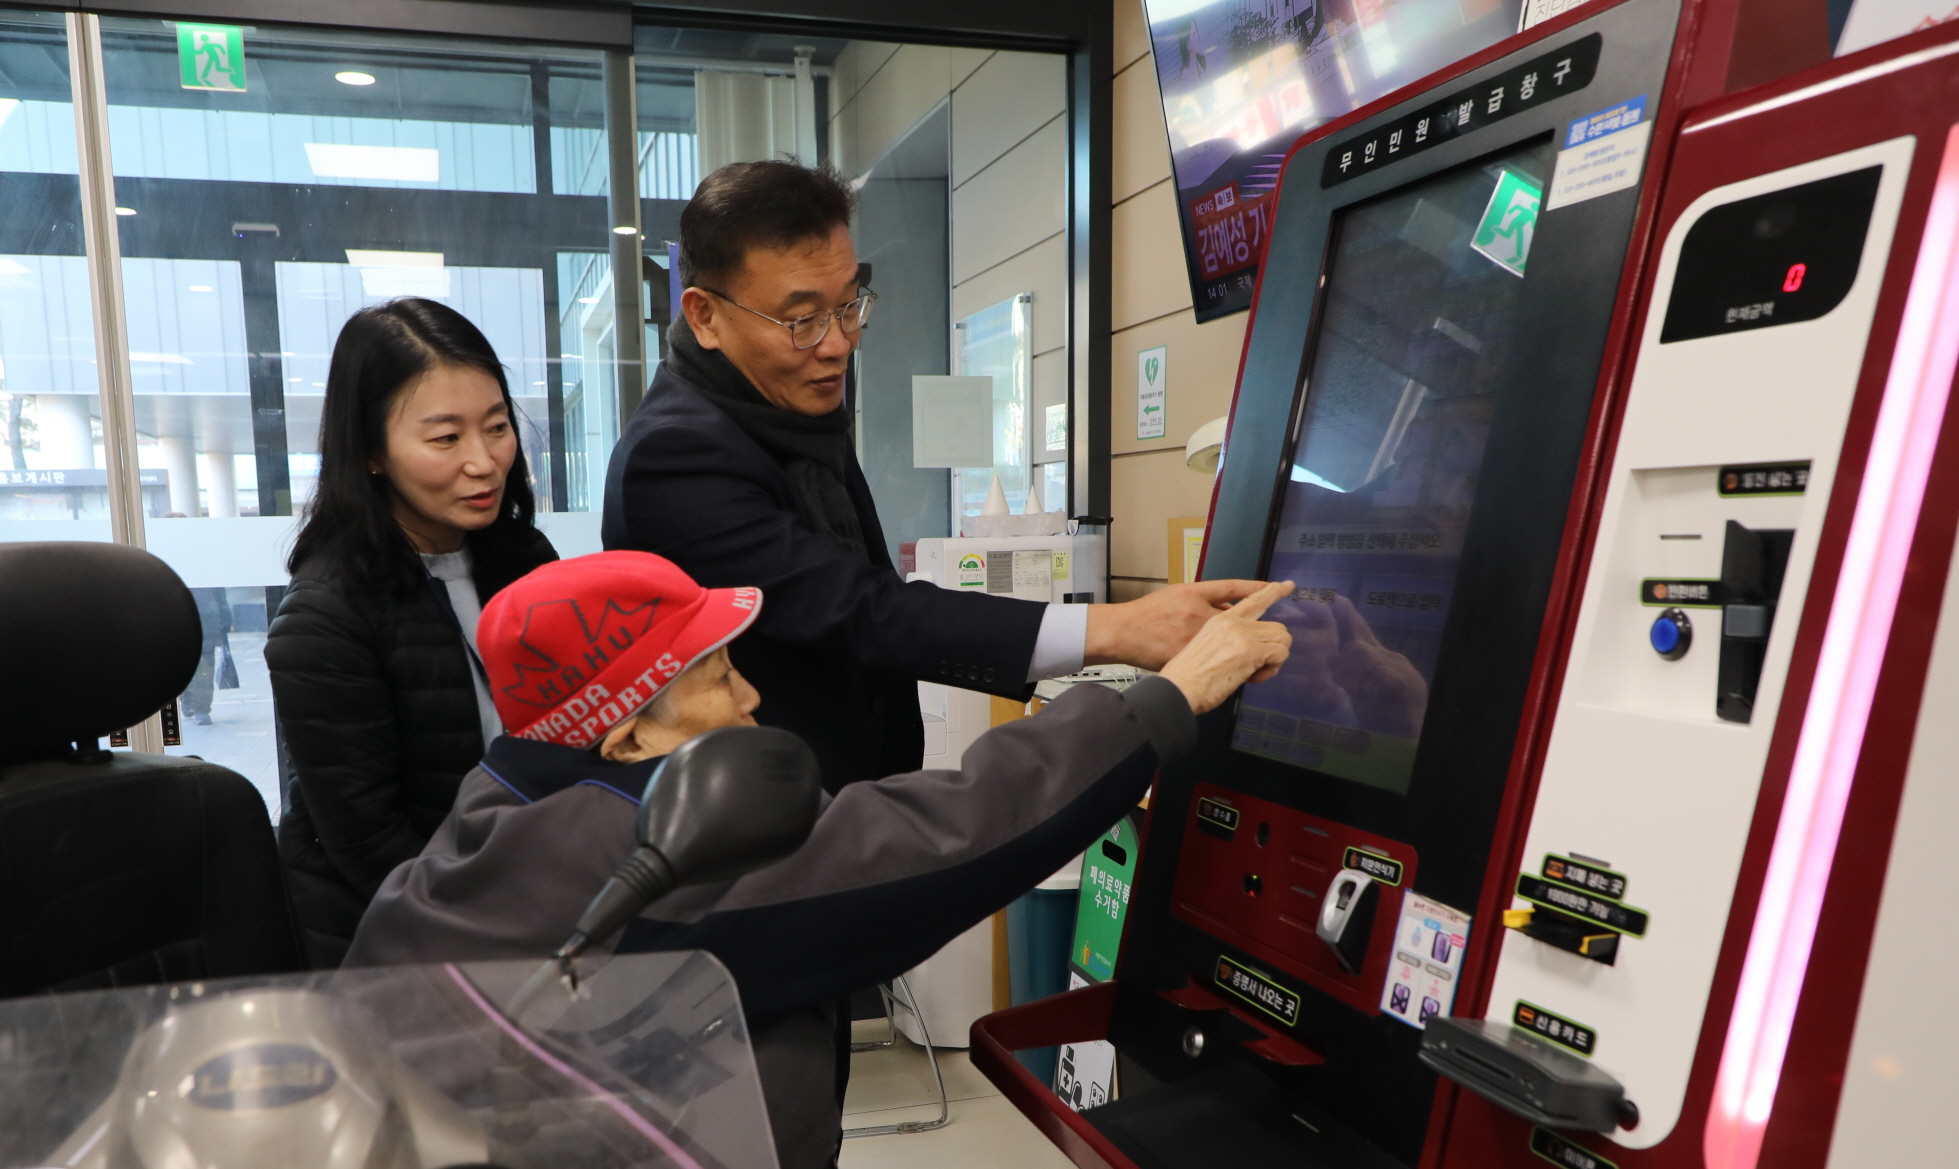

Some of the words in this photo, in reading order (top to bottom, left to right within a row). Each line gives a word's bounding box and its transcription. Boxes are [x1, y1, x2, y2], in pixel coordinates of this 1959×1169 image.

[1195, 199, 1215, 217] NEWS
[1216, 190, 1233, 206] 속보
[1198, 211, 1249, 274] 김예성
[1782, 263, 1807, 292] 0
[1299, 533, 1316, 548] 주소
[1317, 533, 1336, 549] 입력
[732, 587, 755, 610] HY
[564, 652, 683, 749] SPORTS
[1090, 865, 1131, 904] 폐의료약품
[1094, 890, 1120, 920] 수거함
[1233, 970, 1257, 996] 증명서
[1258, 984, 1284, 1010] 나오는
[1284, 998, 1296, 1017] 곳
[1535, 1014, 1588, 1047] 신용카드
